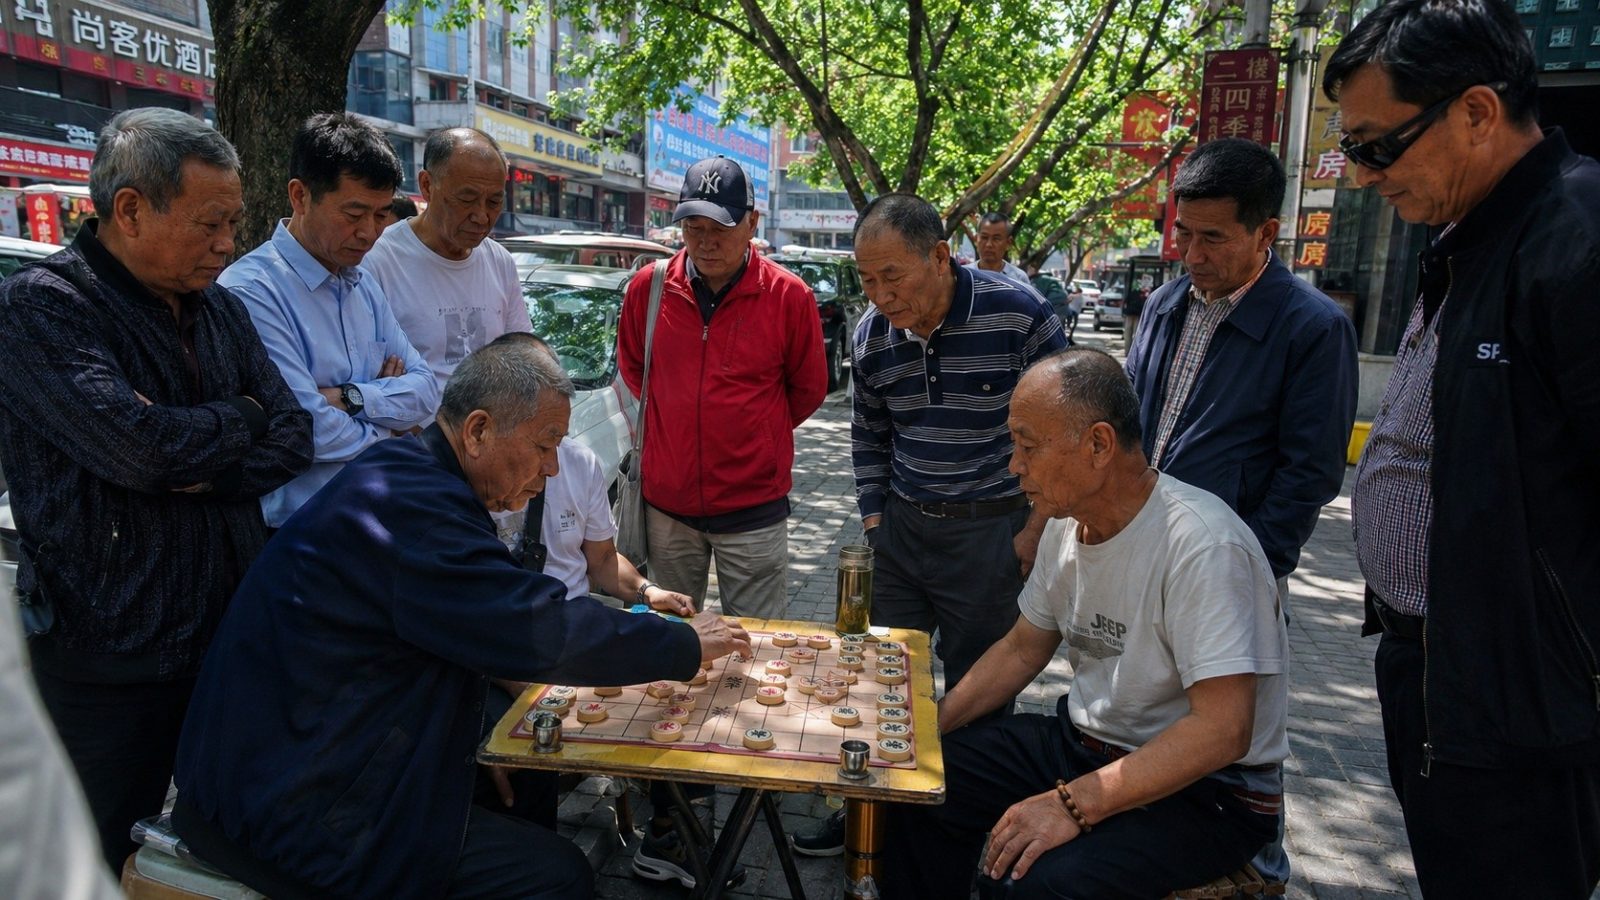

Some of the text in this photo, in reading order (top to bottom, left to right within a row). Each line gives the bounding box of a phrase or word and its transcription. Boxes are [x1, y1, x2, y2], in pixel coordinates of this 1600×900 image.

[1313, 149, 1346, 179] 房
[698, 171, 722, 194] NY
[1090, 613, 1127, 640] JEEP
